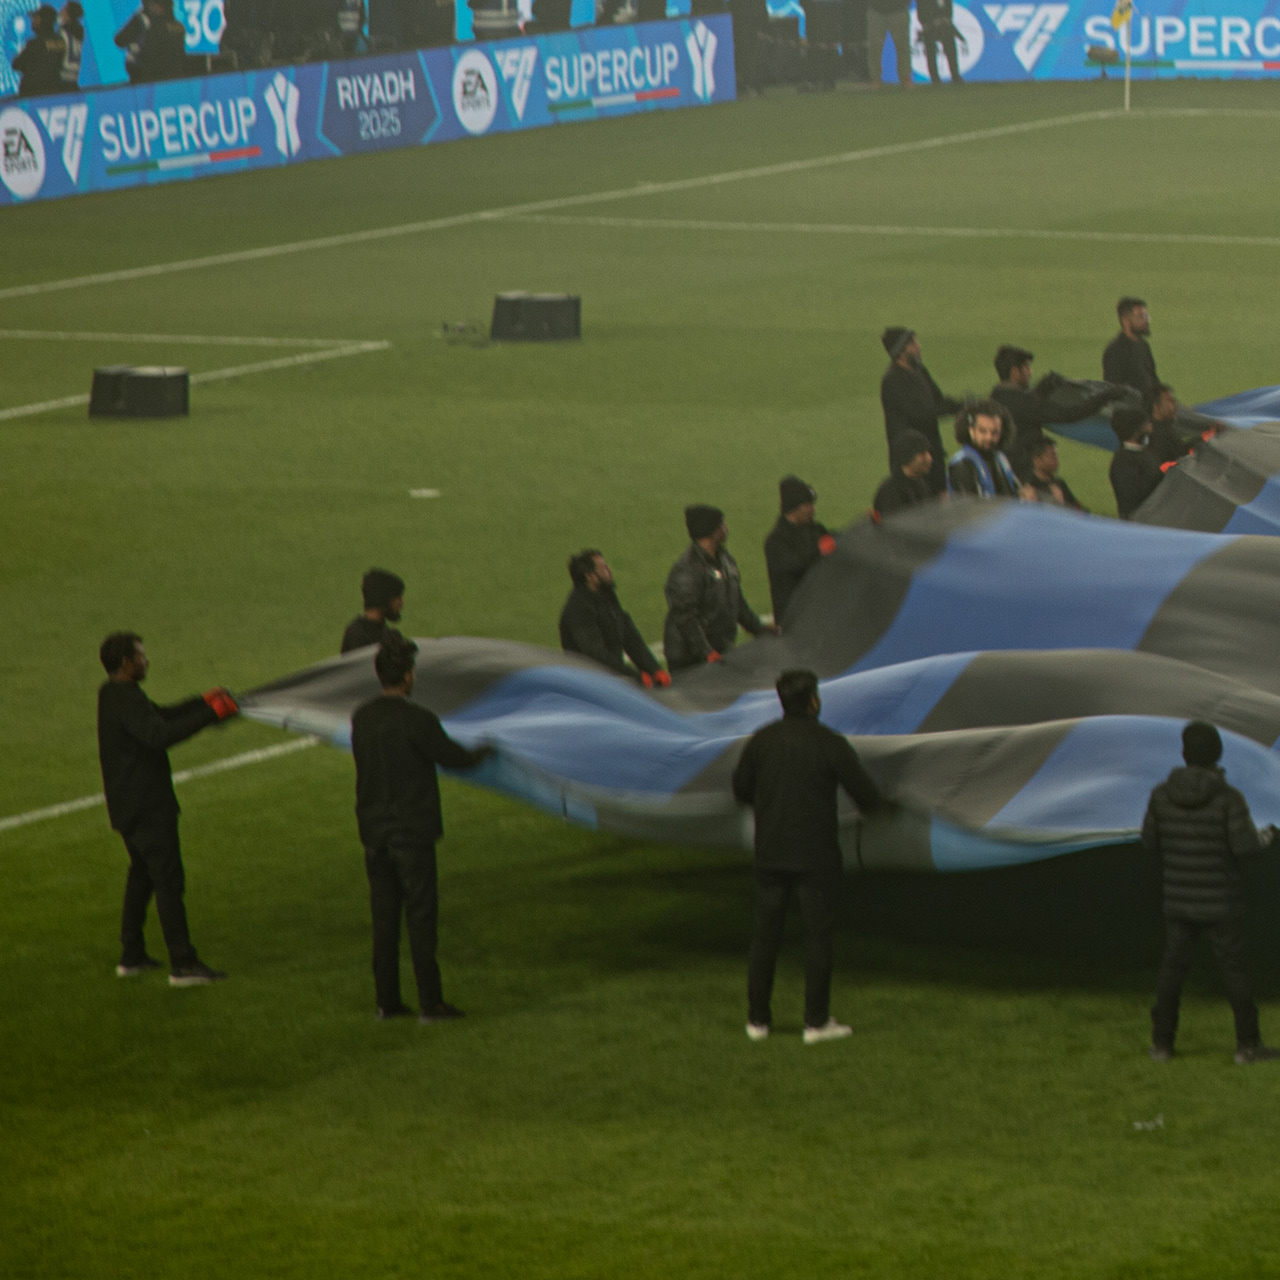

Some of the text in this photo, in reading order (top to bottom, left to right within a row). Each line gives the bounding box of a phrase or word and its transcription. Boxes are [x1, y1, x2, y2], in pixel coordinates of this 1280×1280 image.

[336, 68, 416, 111] RIYADH
[546, 42, 679, 100] SUPERCUP
[3, 129, 35, 158] EA
[100, 96, 257, 161] SUPERCUP
[358, 106, 401, 140] 2025
